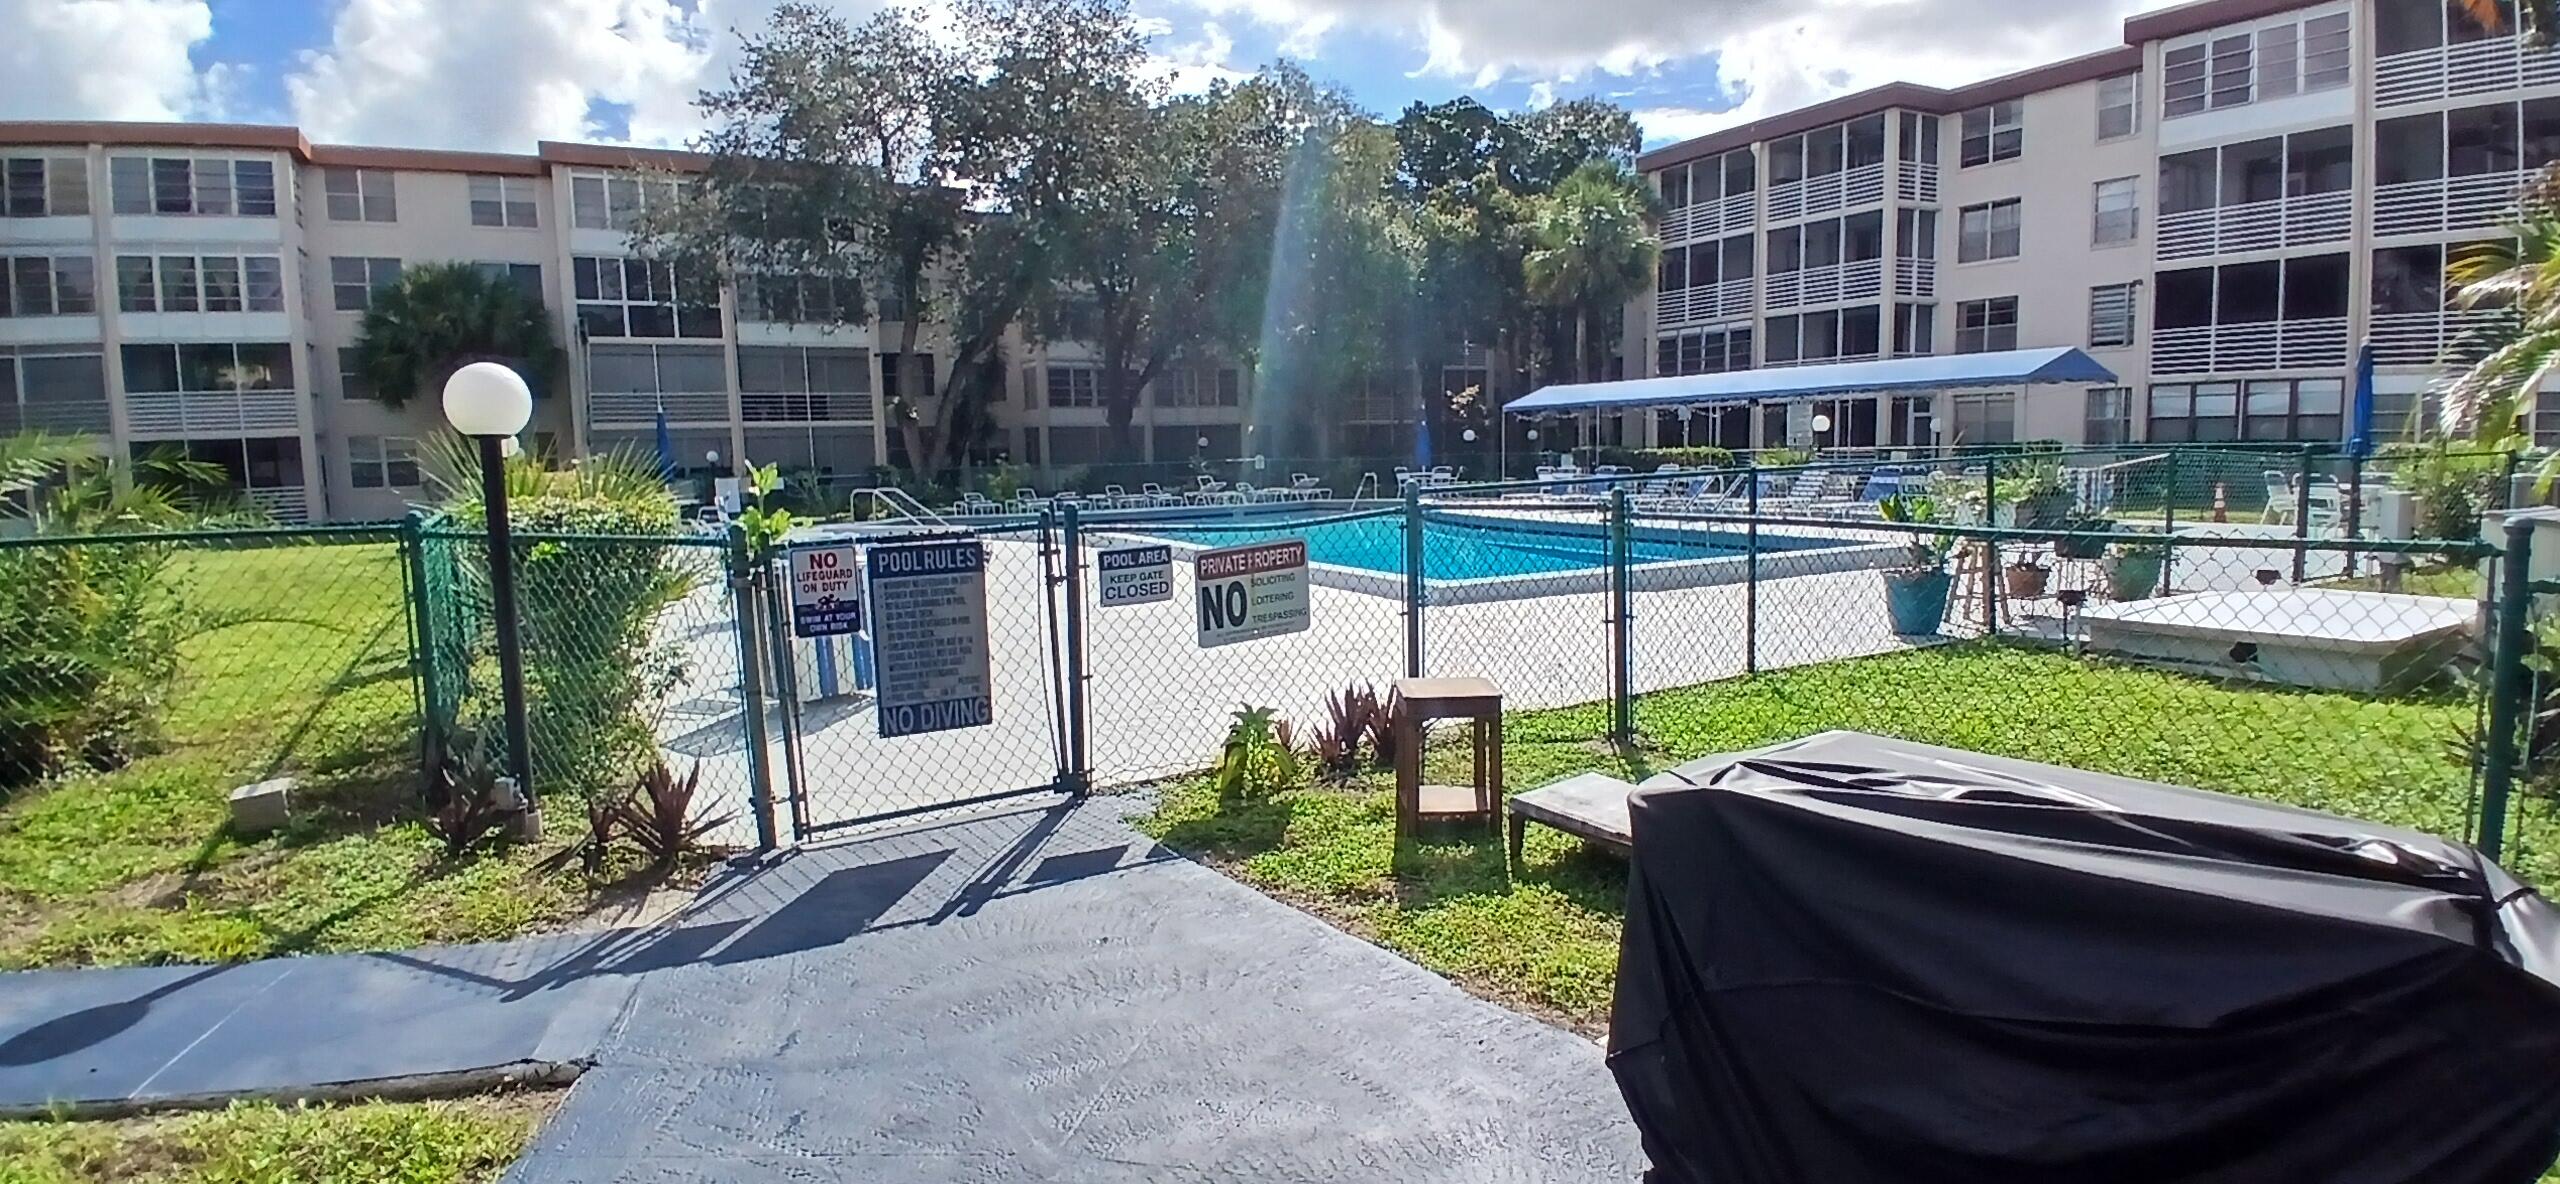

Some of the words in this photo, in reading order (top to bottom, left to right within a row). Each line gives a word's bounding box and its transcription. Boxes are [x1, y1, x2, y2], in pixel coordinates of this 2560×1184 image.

[810, 552, 837, 570] NO
[878, 551, 923, 573] POOL
[924, 548, 976, 570] RULES
[1103, 553, 1136, 569] POOL
[1138, 550, 1169, 566] AREA
[1200, 554, 1246, 576] PRIVATE
[796, 568, 853, 582] LIFEGUARD
[1110, 573, 1137, 585] KEEP
[1139, 570, 1164, 581] GATE
[1251, 573, 1295, 588] SOLICITING
[803, 583, 817, 593] ON
[822, 581, 848, 592] DUTY
[1105, 581, 1170, 600] CLOSED
[1201, 581, 1248, 631] NO
[1251, 591, 1294, 606] LOITERING
[824, 613, 833, 622] AT
[835, 612, 856, 621] YOUR
[1252, 608, 1307, 623] TRESPASSING
[883, 706, 914, 735] NO
[921, 697, 989, 729] DIVING
